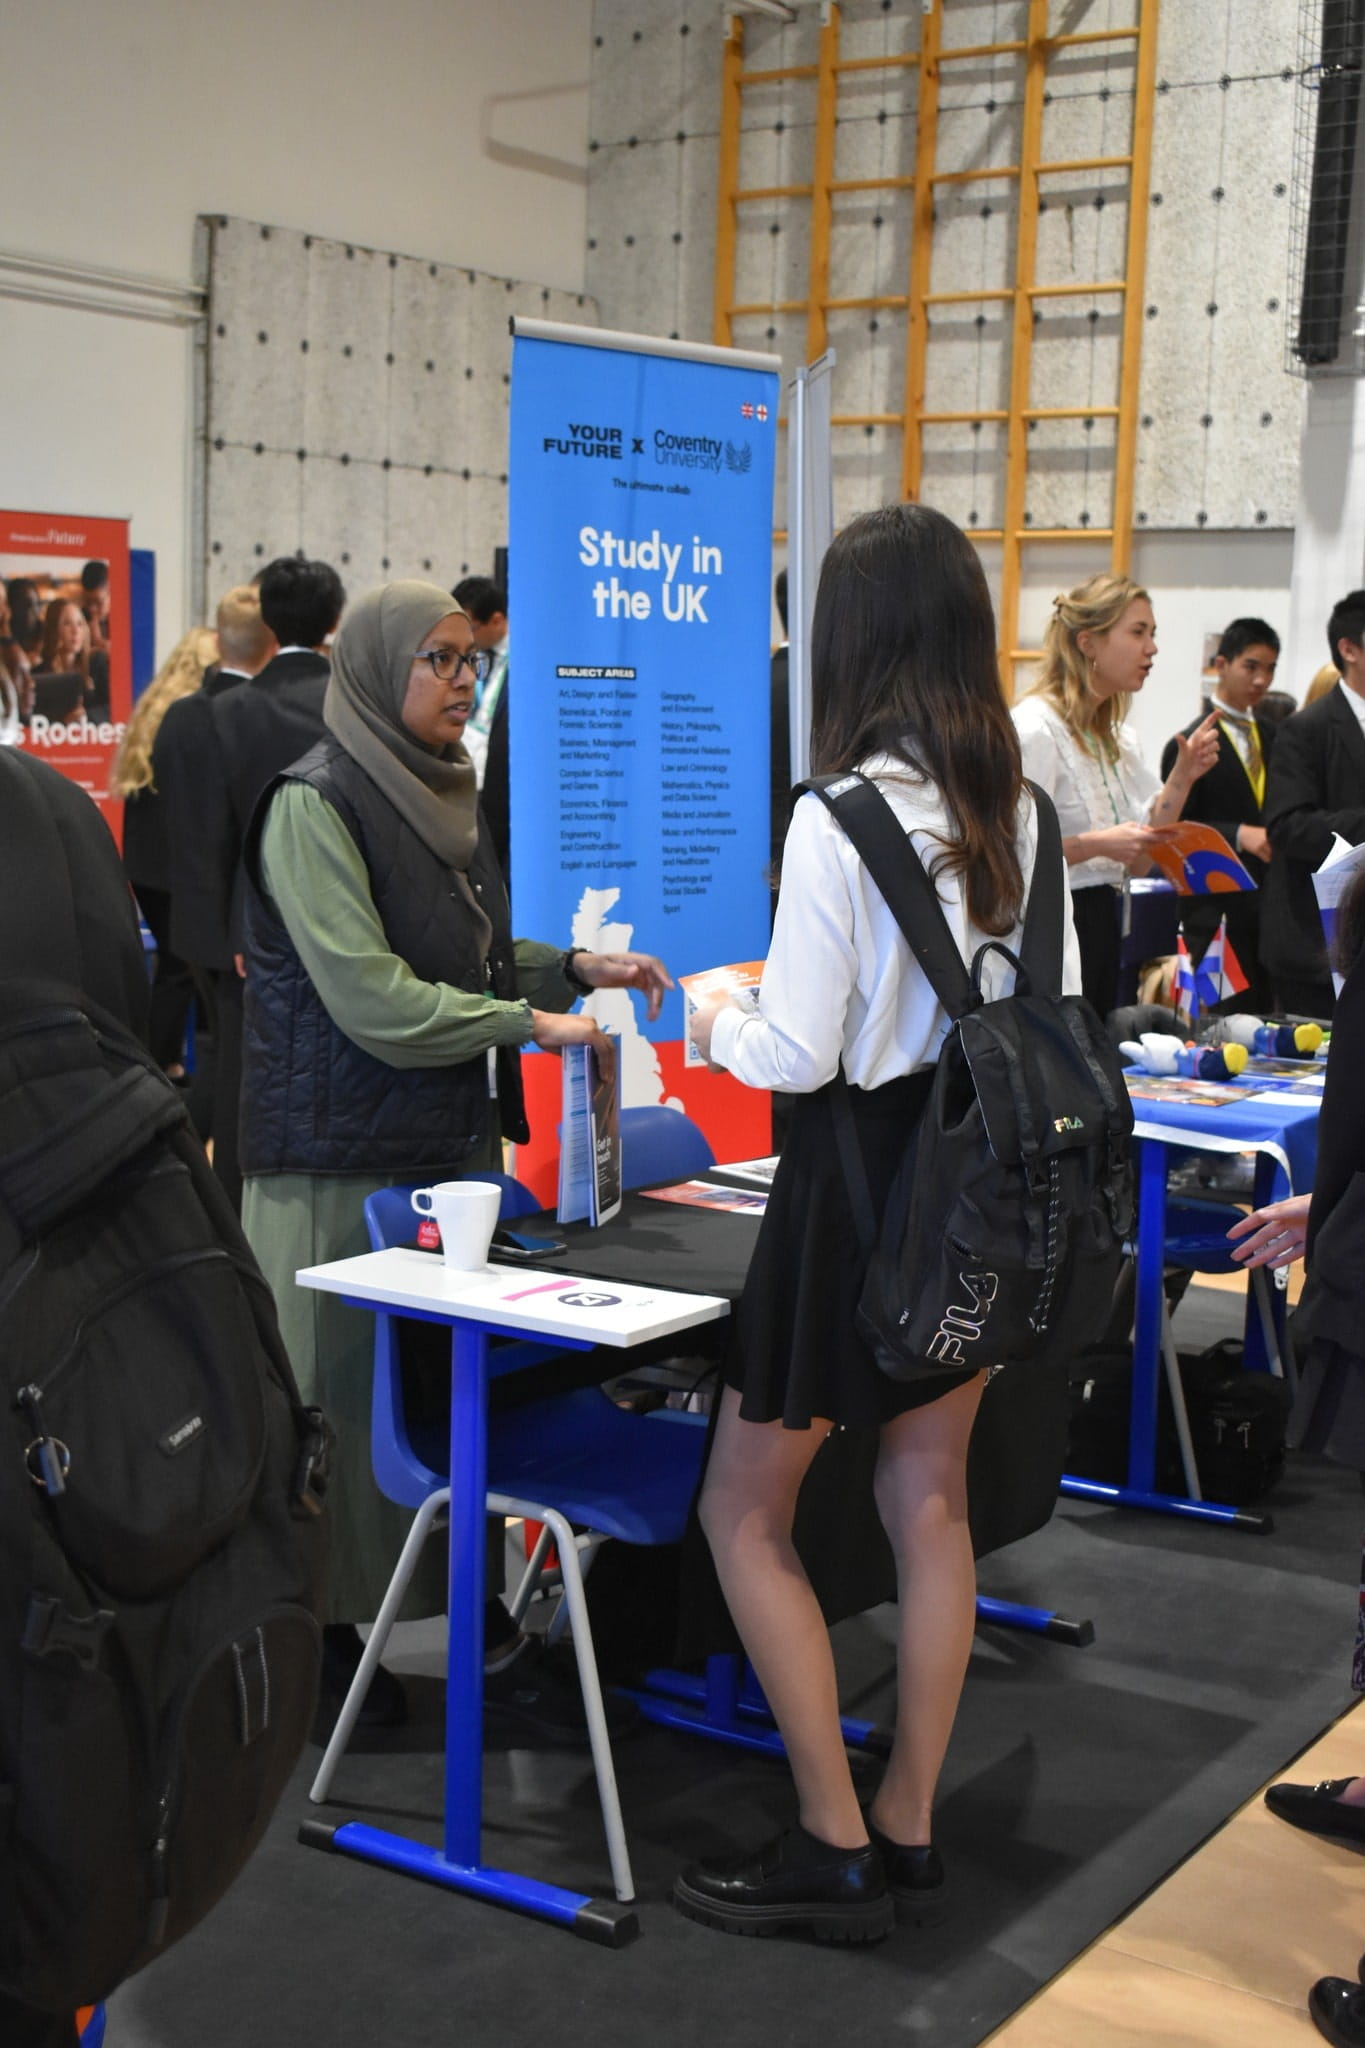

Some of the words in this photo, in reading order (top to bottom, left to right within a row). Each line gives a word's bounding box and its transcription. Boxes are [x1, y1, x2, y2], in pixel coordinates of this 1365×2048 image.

[568, 424, 623, 442] YOUR
[654, 430, 723, 457] Coventry
[543, 438, 623, 460] FUTURE
[654, 450, 723, 474] University
[612, 478, 627, 489] The
[629, 480, 664, 492] ultimate
[578, 526, 683, 583] Study
[693, 535, 722, 575] in
[592, 576, 651, 620] the
[662, 583, 709, 623] UK
[558, 667, 603, 678] SUBJECT
[604, 668, 635, 679] AREAS
[1054, 1115, 1085, 1134] FILA
[926, 1272, 998, 1365] FILA
